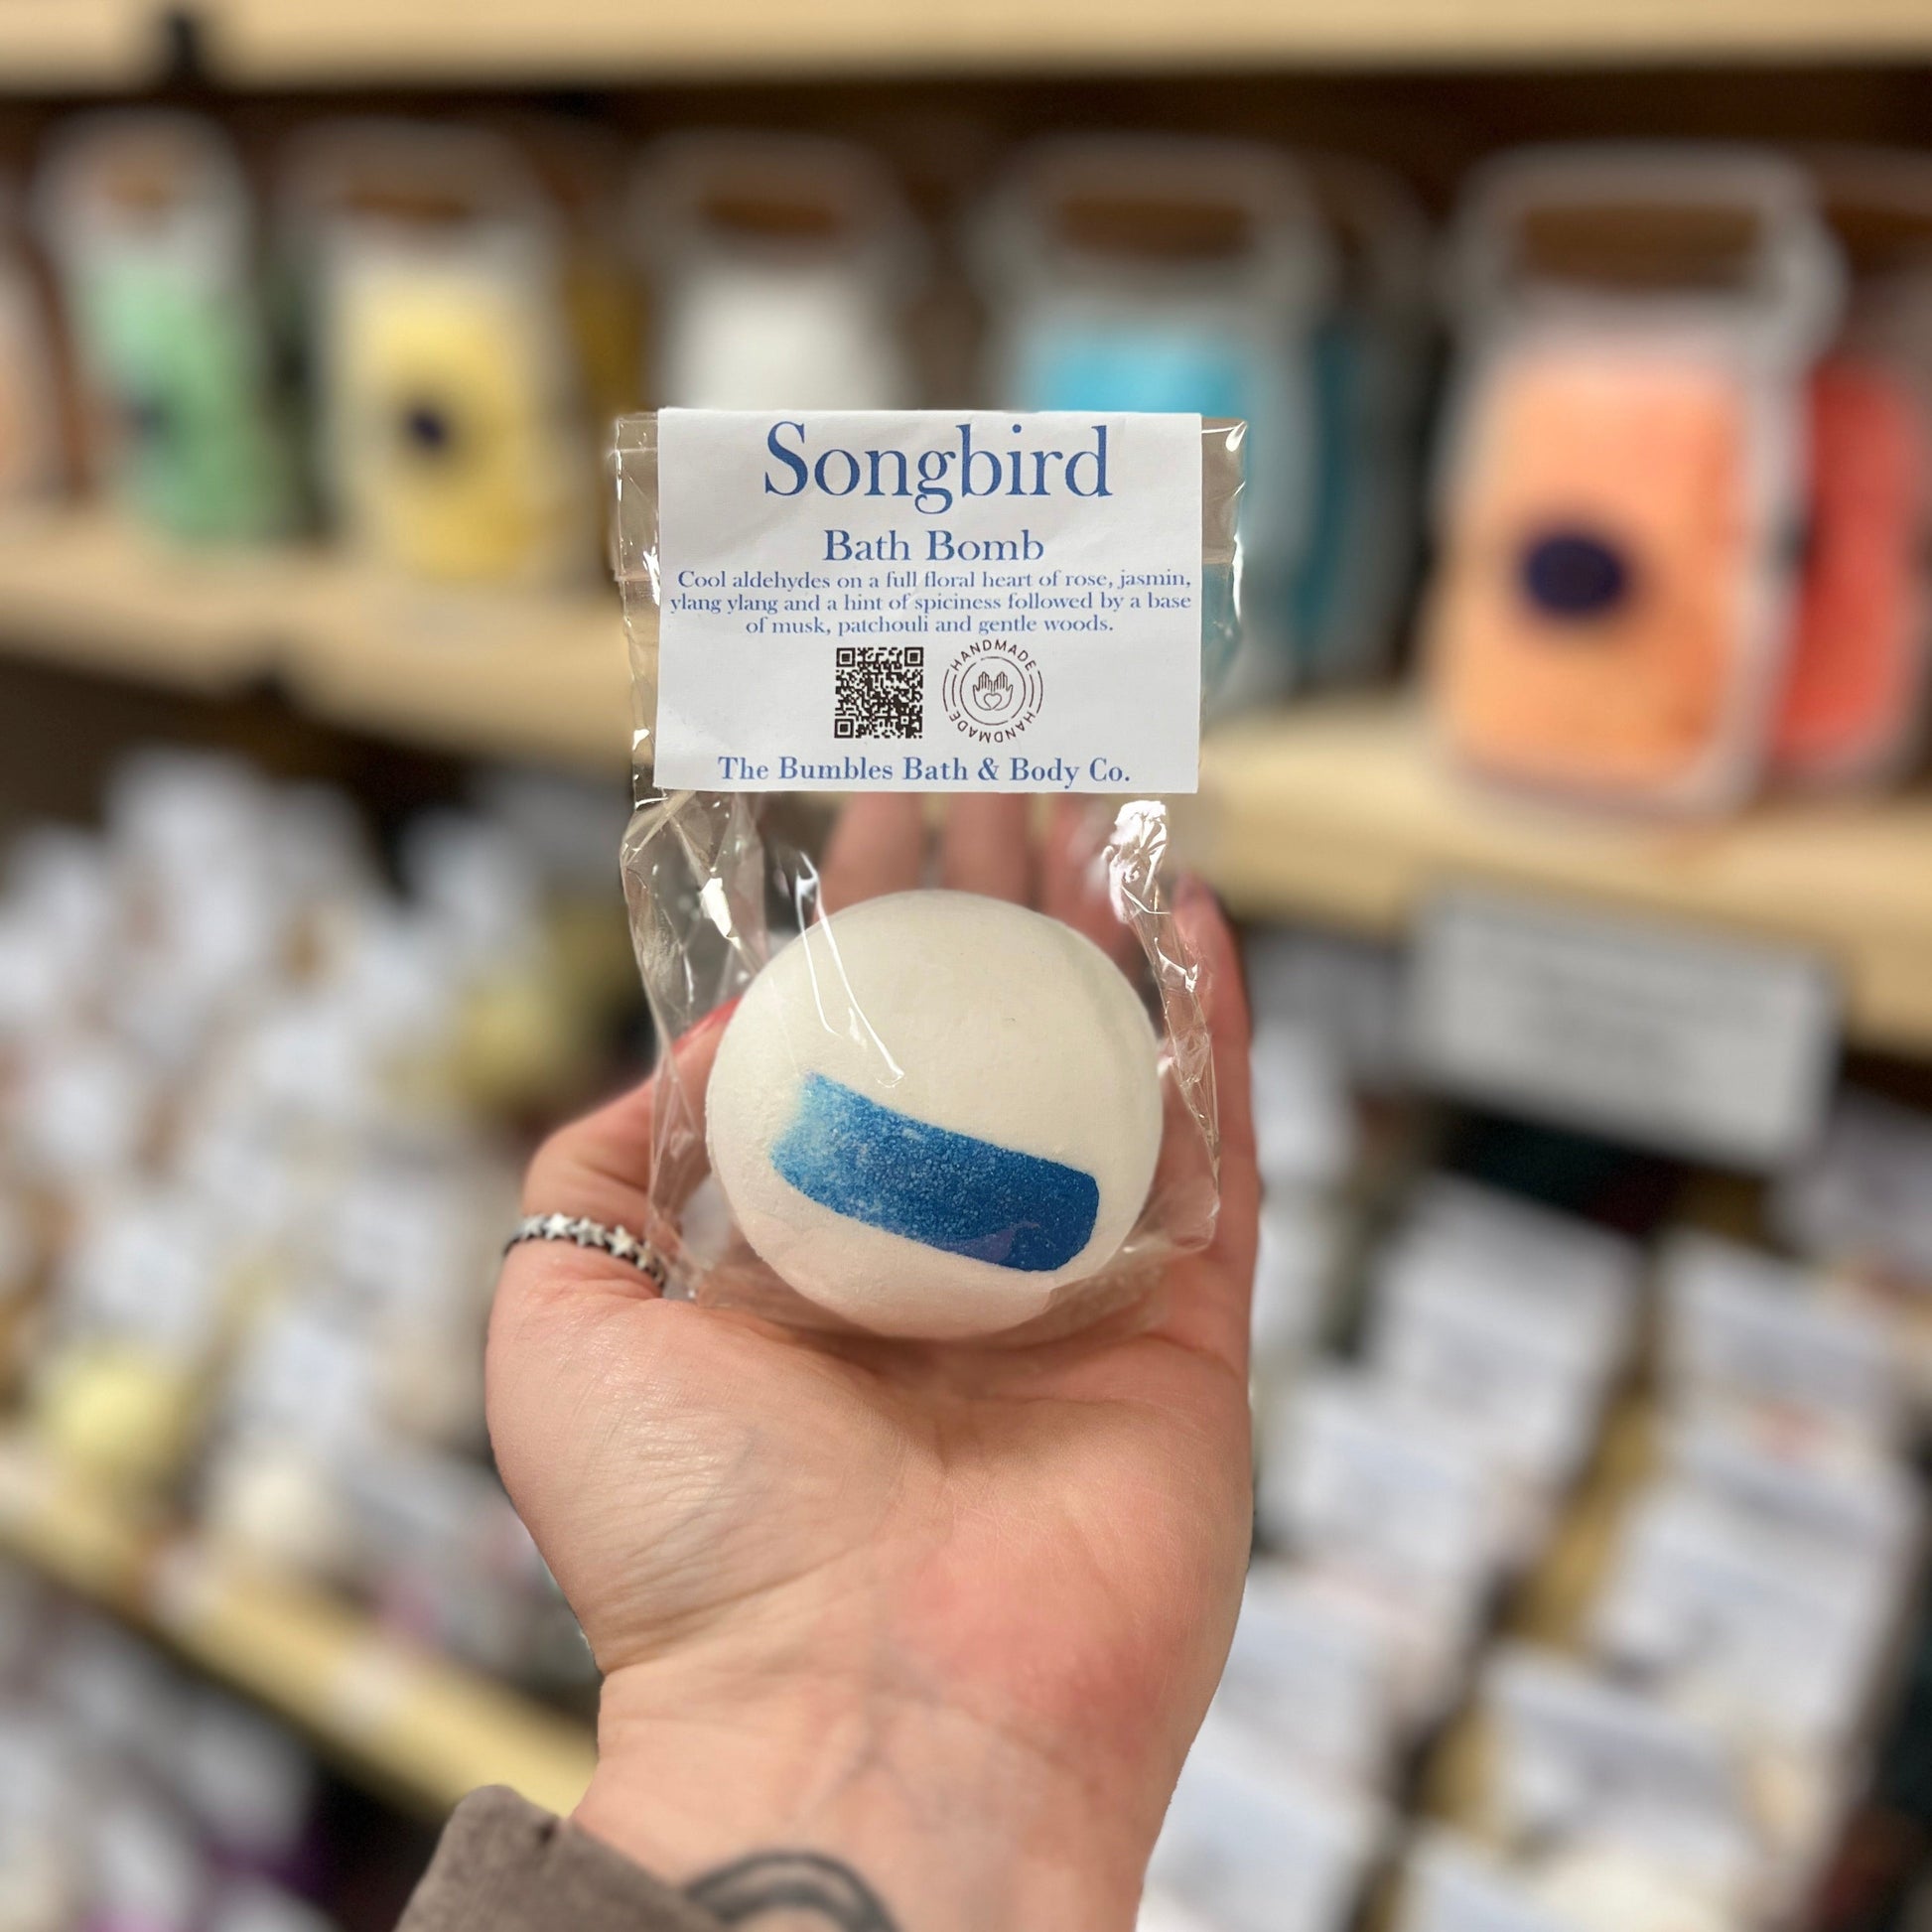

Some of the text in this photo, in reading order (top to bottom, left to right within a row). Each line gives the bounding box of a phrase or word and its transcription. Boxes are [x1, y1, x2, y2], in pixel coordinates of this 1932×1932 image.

[764, 421, 1113, 514] Songbird
[823, 529, 1043, 561] Bath Bomb
[677, 568, 1191, 593] Cool aldehydes on a full floral heart of rose, jasmin,
[669, 591, 1191, 615] ylang ylang and a hint of spiciness followed by a base
[745, 614, 1114, 637] of musk, patchouli and gentle woods.
[950, 639, 1036, 671] HANDMADE
[949, 711, 1035, 743] HANDMADE
[717, 756, 1129, 789] The Bumbles Bath & Body Co.
